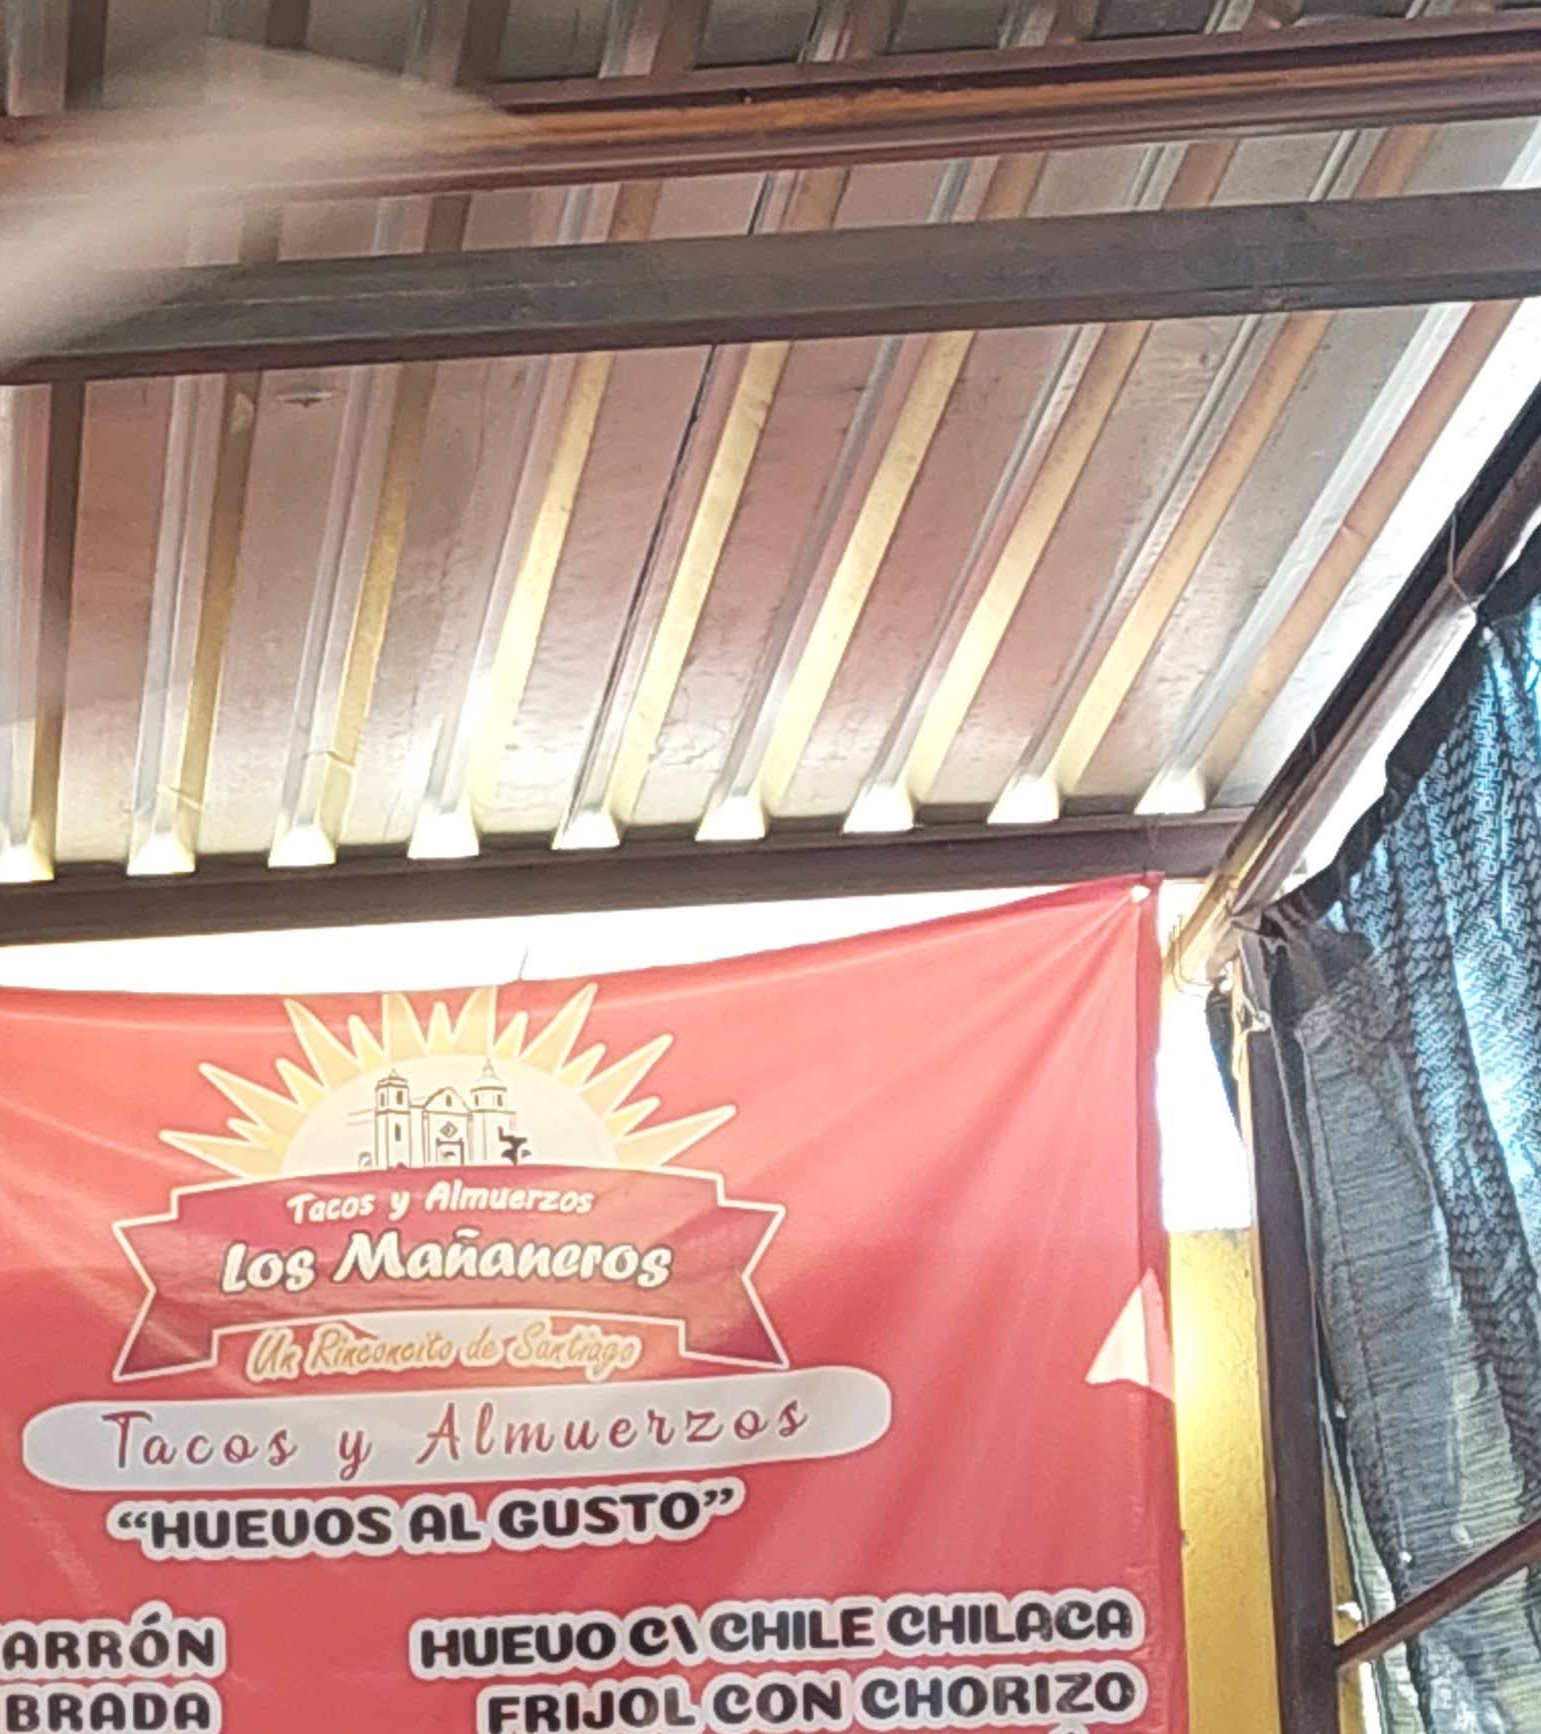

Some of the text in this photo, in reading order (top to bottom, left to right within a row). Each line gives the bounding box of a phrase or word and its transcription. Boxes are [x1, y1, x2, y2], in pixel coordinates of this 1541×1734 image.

[288, 1181, 597, 1225] Tacos y Almuerzos
[221, 1226, 674, 1293] Los Mañaneros
[465, 1324, 499, 1360] de
[513, 1322, 638, 1376] Santiago
[103, 1397, 810, 1480] Tacos y Almuerzos
[410, 1503, 481, 1543] AL
[709, 1605, 876, 1652] CHILE
[887, 1597, 1133, 1644] CHILACA
[710, 1679, 841, 1724] CON
[860, 1672, 1136, 1721] CHORIZO
